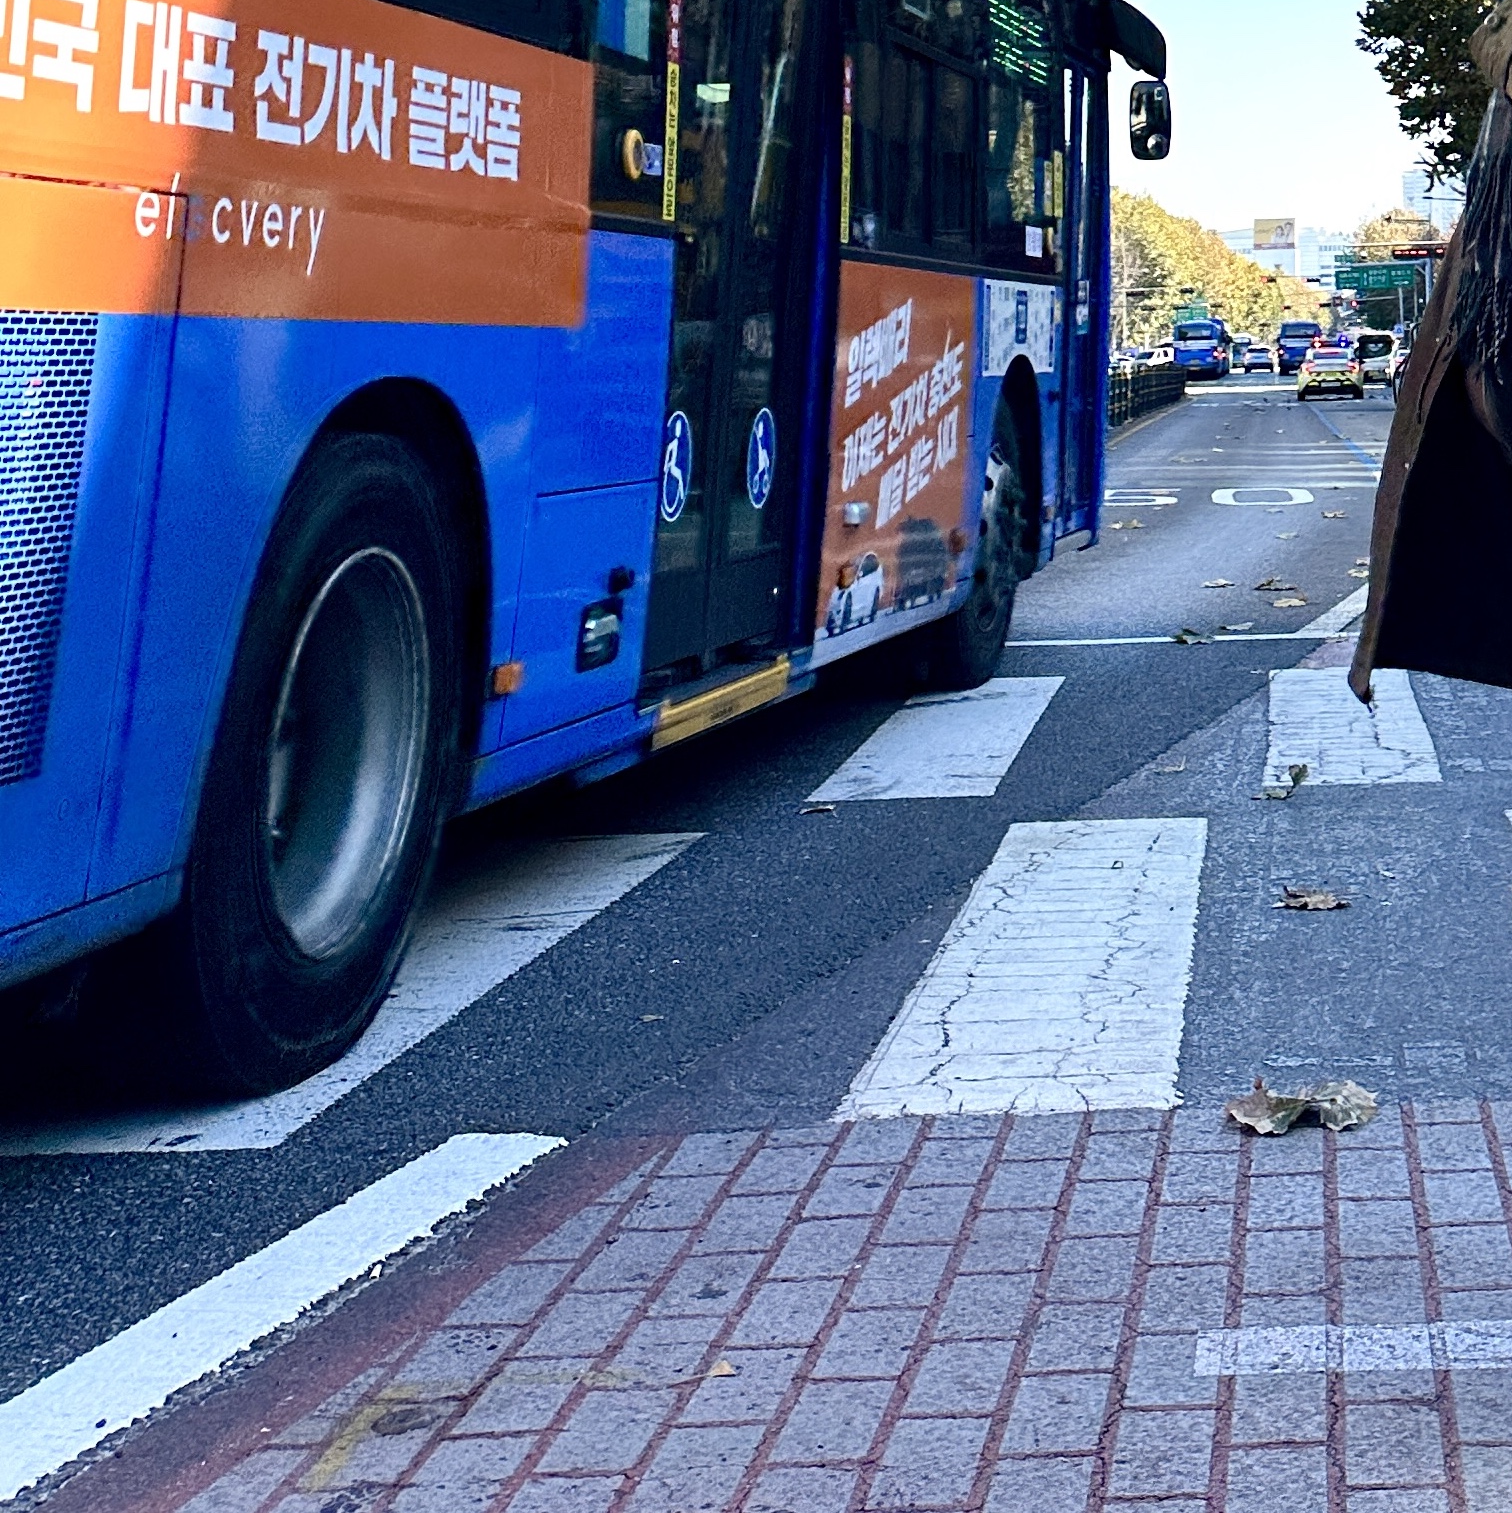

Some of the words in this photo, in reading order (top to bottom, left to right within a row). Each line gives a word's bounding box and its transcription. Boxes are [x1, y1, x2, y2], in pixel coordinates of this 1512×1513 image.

[254, 29, 398, 161] 전기차
[408, 65, 521, 182] 플랫폼
[842, 411, 887, 492] 이제는
[887, 371, 929, 455] 전기차
[933, 405, 959, 474] 시대
